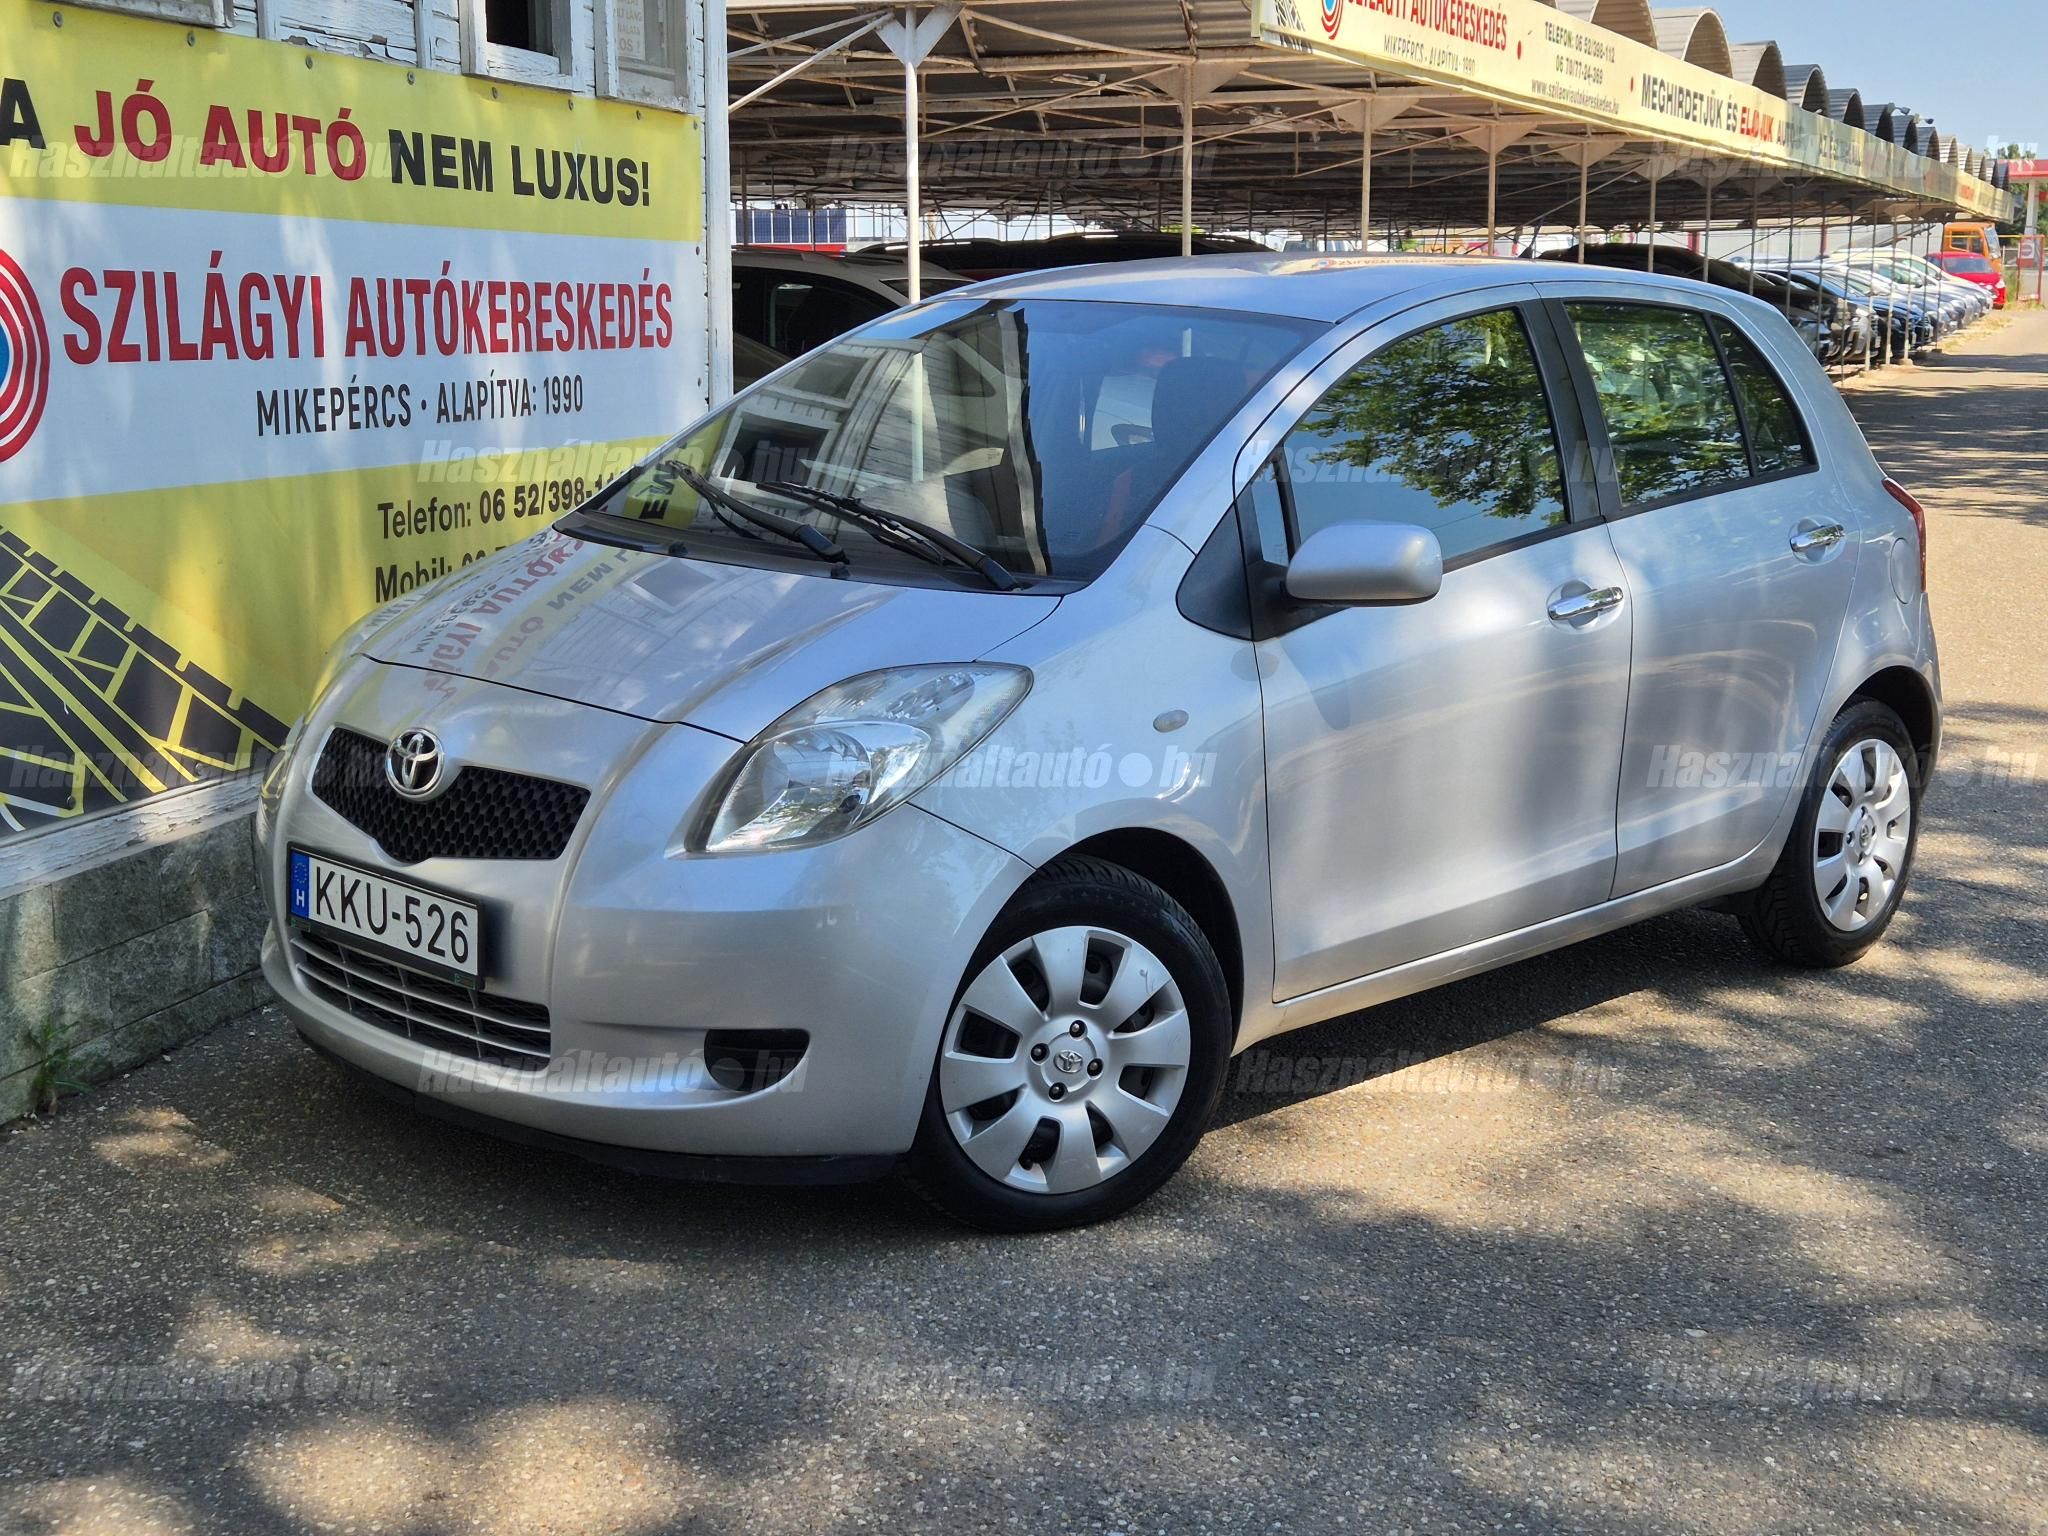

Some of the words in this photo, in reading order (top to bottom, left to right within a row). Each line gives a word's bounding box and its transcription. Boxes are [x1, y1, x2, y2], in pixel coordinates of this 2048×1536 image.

[74, 79, 172, 162] JÓ
[200, 107, 367, 182] AUTÓ
[389, 129, 494, 193] NEM
[511, 145, 650, 207] LUXUS!
[1641, 73, 1723, 129] MEGHIRDETJÜK
[1726, 94, 1738, 133] ÉS
[60, 251, 325, 364] SZILÁGYI
[345, 260, 673, 358] AUTÓKERESKEDÉS
[256, 374, 412, 436] MIKEPÉRCS
[437, 369, 537, 423] ALAPÍTVA:
[543, 374, 583, 414] 1990
[378, 498, 472, 540] Telefon:
[479, 488, 505, 525] 06
[296, 889, 305, 907] H
[316, 866, 468, 964] KKU-526
